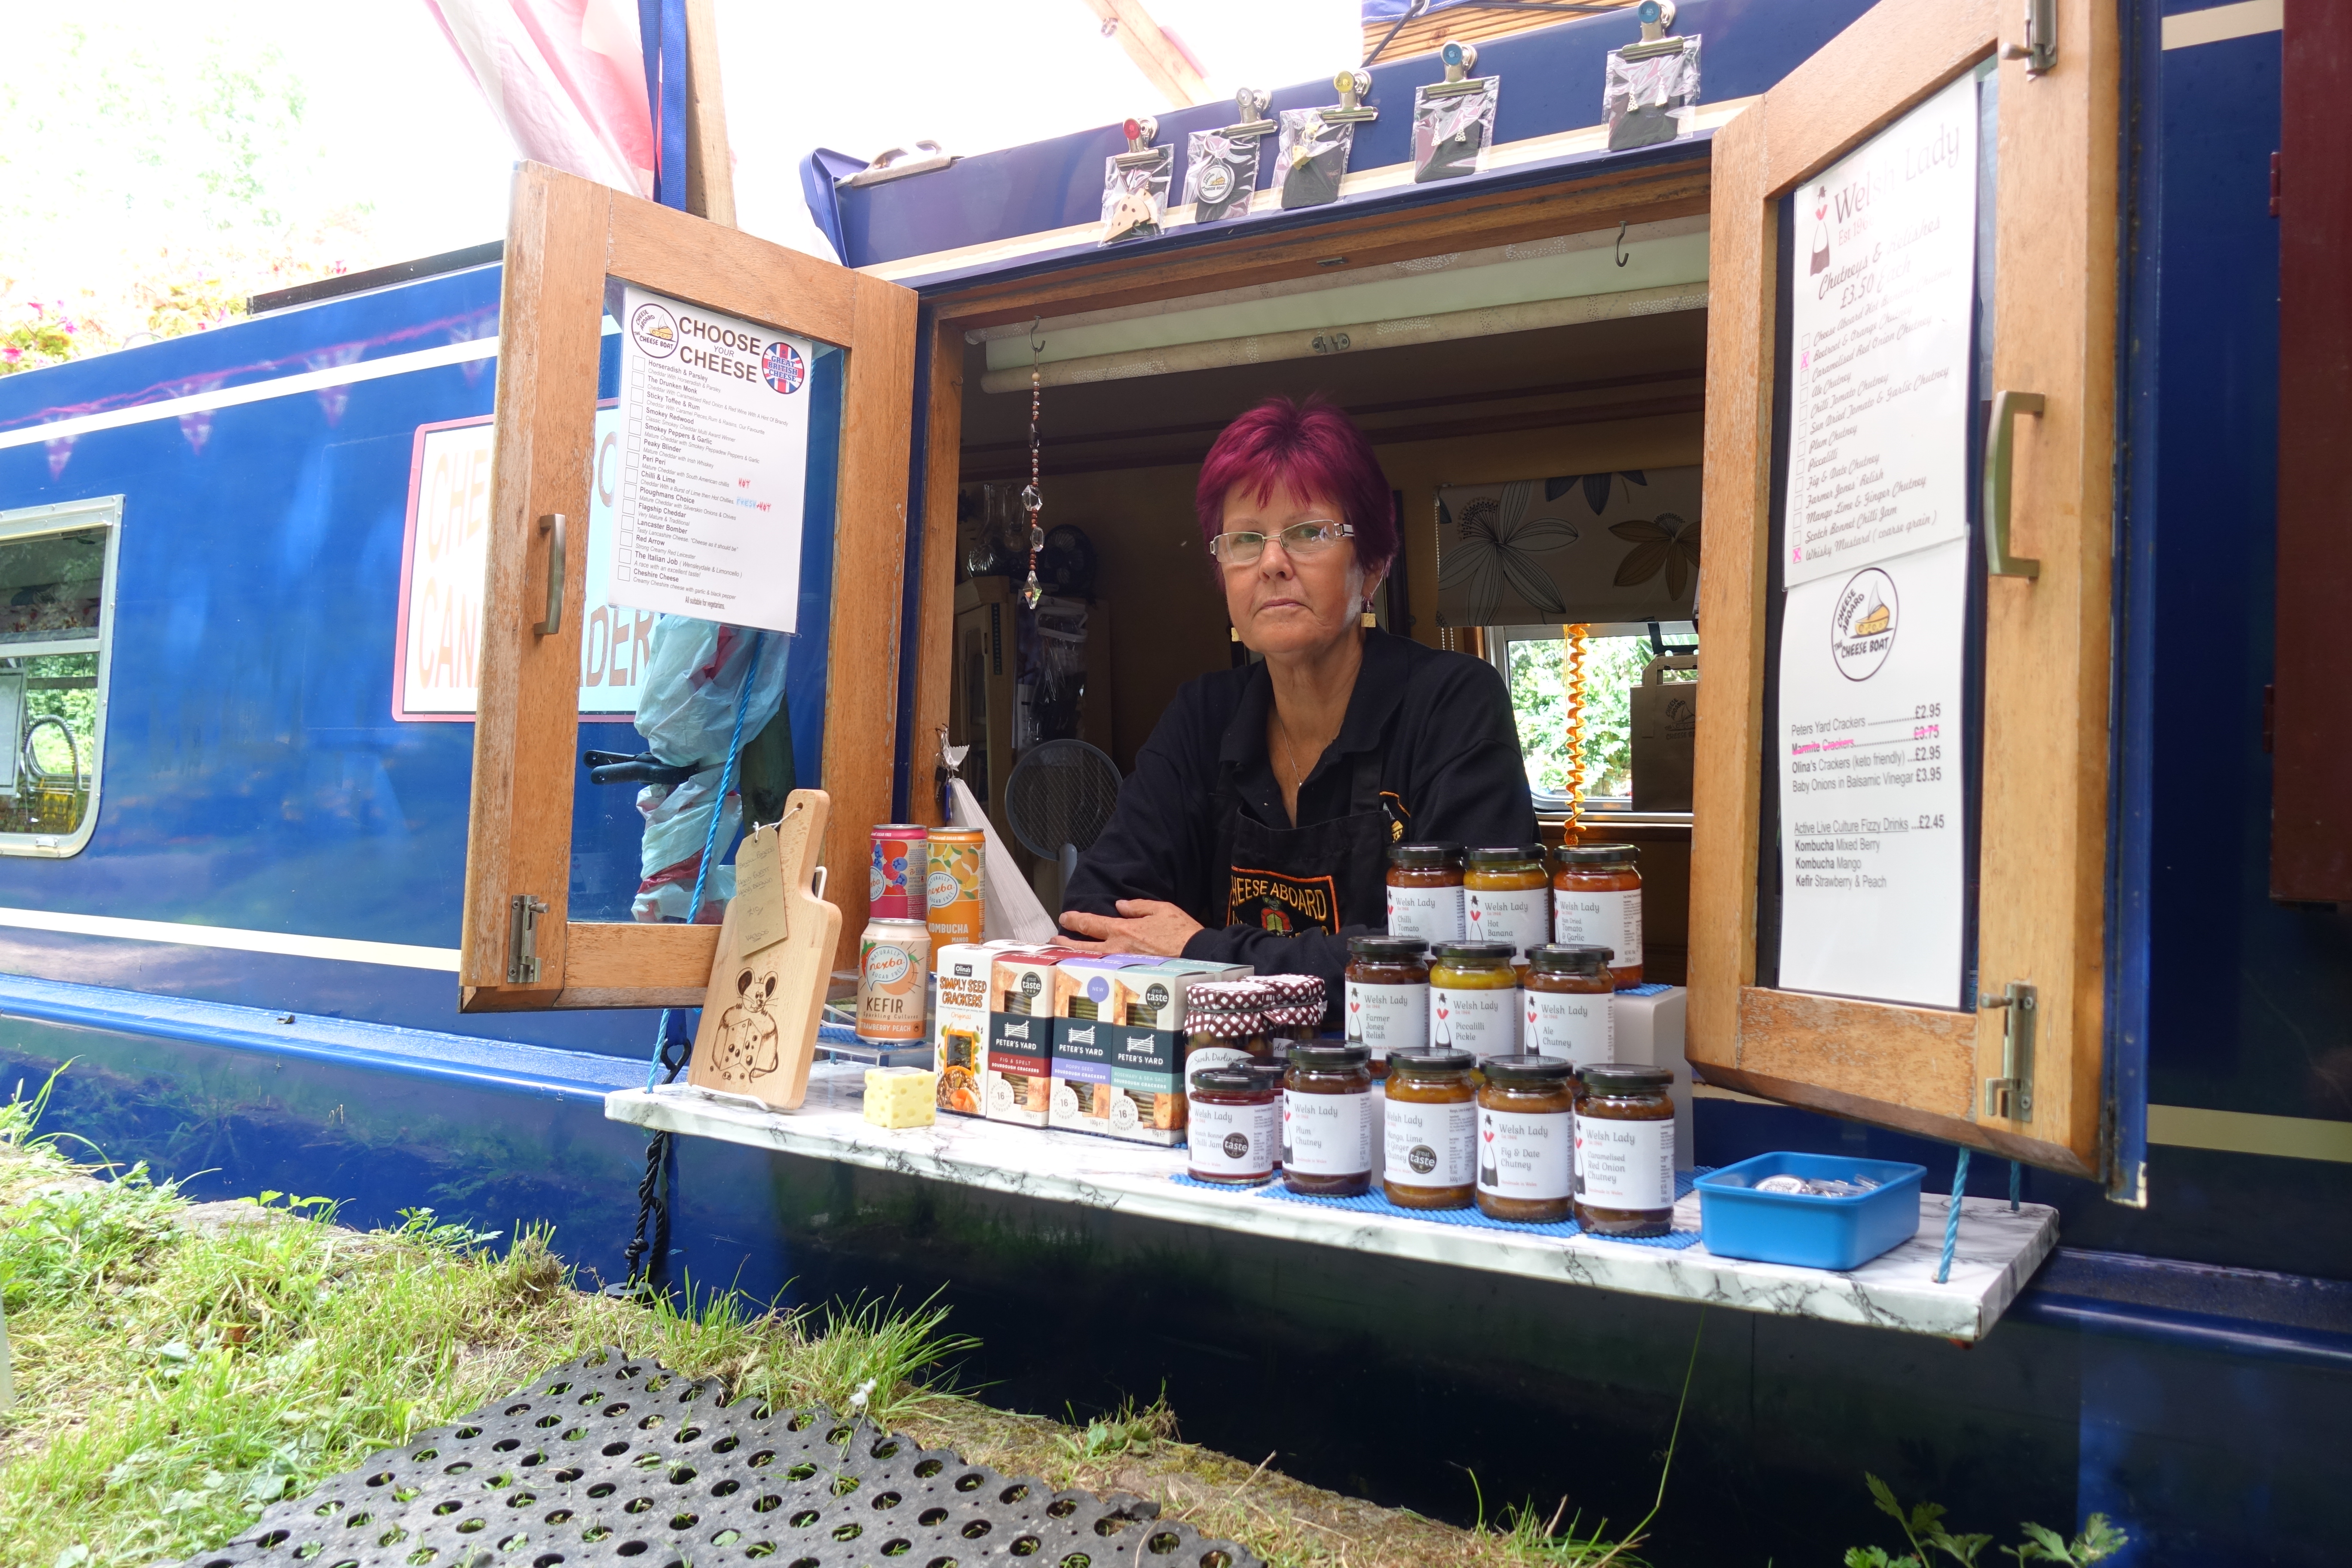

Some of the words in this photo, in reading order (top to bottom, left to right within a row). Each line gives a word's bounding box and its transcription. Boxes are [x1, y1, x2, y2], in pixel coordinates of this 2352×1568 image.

[1906, 122, 1959, 182] Lady
[1819, 255, 1868, 300] Chutneys
[1841, 272, 1874, 309] £3.50
[636, 309, 649, 325] CHEESE
[640, 315, 655, 331] ABOARD
[639, 336, 658, 346] CHEESE
[660, 341, 674, 350] BOAT
[679, 316, 761, 356] CHOOSE
[714, 345, 734, 358] YOUR
[680, 346, 757, 383] CHEESE
[768, 361, 798, 375] BRITISH
[771, 356, 795, 368] GREAT
[648, 359, 682, 374] Horseradish
[688, 370, 708, 383] Parsley
[769, 369, 796, 382] CHEESE
[647, 375, 658, 383] The
[659, 378, 682, 390] Drunken
[683, 385, 697, 394] Monk
[646, 391, 664, 402] Sticky
[665, 395, 681, 405] Toffee
[688, 401, 700, 410] Rum
[646, 406, 668, 419] Smokey
[669, 412, 694, 424] Redwood
[645, 422, 667, 435] Smokey
[668, 428, 690, 439] Peppers
[697, 435, 712, 445] Garlic
[1808, 438, 1827, 454] Plum
[1828, 425, 1857, 446] Chutney
[643, 438, 660, 450] Peaky
[662, 442, 681, 453] Blinder
[642, 454, 653, 462] Peri
[654, 457, 665, 465] Peri
[641, 470, 655, 479] Chilli
[662, 475, 676, 484] Lime
[1806, 475, 1819, 490] Fig
[1829, 465, 1847, 479] Date
[1848, 454, 1880, 475] Chutney
[738, 478, 750, 489] HOT
[640, 486, 674, 499] Ploughmans
[675, 494, 695, 504] Choice
[638, 502, 662, 514] Flagship
[663, 507, 686, 518] Cheddar
[736, 497, 756, 509] FRESH
[637, 518, 665, 530] Lancaster
[665, 524, 688, 534] Bomber
[1804, 526, 1828, 544] Scotch
[1829, 518, 1855, 536] Bonnet
[1856, 511, 1877, 529] Chilli
[1878, 506, 1897, 522] Jam
[636, 534, 647, 542] Red
[647, 536, 665, 545] Arrow
[634, 550, 646, 559] The
[647, 553, 665, 563] Italian
[666, 557, 678, 565] Job
[633, 568, 658, 579] Cheshire
[659, 573, 679, 582] Cheese
[1837, 589, 1856, 628] CHEESE
[1843, 594, 1865, 635] ABOARD
[1841, 642, 1867, 659] CHEESE
[1869, 637, 1890, 652] BOAT
[1791, 724, 1813, 736] Peters
[1814, 720, 1831, 733] Yard
[1832, 717, 1865, 731] Crackers
[1792, 760, 1817, 774] Olina's
[1818, 758, 1850, 771] Crackers
[1852, 755, 1871, 769] (keto
[1873, 751, 1905, 766] friendly)
[1792, 780, 1810, 793] Baby
[1811, 778, 1836, 791] Onions
[1838, 778, 1844, 788] in
[1846, 775, 1880, 788] Balsamic
[1883, 772, 1914, 786] Vinegar
[1915, 767, 1942, 782] £3.95
[1794, 822, 1815, 834] Active
[1816, 821, 1831, 833] Live
[1832, 820, 1859, 833] Culture
[1861, 818, 1880, 832] Fizzy
[1883, 818, 1908, 831] Drinks
[1795, 839, 1834, 851] Kombucha
[1836, 838, 1857, 851] Mixed
[1859, 837, 1880, 852] Berry
[1795, 857, 1835, 869] Kombucha
[1836, 857, 1861, 871] Mango
[1795, 874, 1813, 887] Kefir
[1814, 874, 1852, 889] Strawberry
[1862, 874, 1886, 888] Peach
[928, 882, 952, 896] nexba
[1231, 875, 1268, 906] HEESE
[1270, 882, 1327, 921] ABOARD
[1484, 902, 1508, 911] Welsh
[1510, 902, 1528, 913] Lady
[928, 923, 968, 934] KOMBUCHA
[870, 958, 902, 971] nexba
[940, 976, 967, 991] SIMPLY
[968, 979, 987, 993] SEED
[1022, 981, 1041, 990] taste
[867, 996, 903, 1013] KEFIR
[942, 991, 983, 1008] CRACKERS
[1364, 995, 1387, 1004] Welsh
[1390, 995, 1408, 1007] Lady
[1453, 1001, 1478, 1010] Welsh
[1480, 1001, 1498, 1012] Lady
[951, 1012, 971, 1020] Original
[1366, 1013, 1390, 1022] Farmer
[1541, 1004, 1565, 1014] Welsh
[1568, 1006, 1588, 1017] Lady
[1456, 1022, 1485, 1030] Piccalilli
[1543, 1026, 1553, 1035] Ale
[1366, 1030, 1385, 1039] Relish
[1455, 1032, 1476, 1041] Pickle
[996, 1039, 1019, 1048] PETER'S
[1059, 1044, 1083, 1054] PETER'S
[1085, 1047, 1103, 1056] YARD
[1543, 1037, 1571, 1049] Chutney
[1118, 1053, 1142, 1063] PETER'S
[1144, 1057, 1163, 1065] YARD
[1294, 1104, 1315, 1114] Welsh
[1318, 1106, 1338, 1118] Lady
[1296, 1125, 1311, 1135] Plum
[1499, 1124, 1525, 1135] Welsh
[1528, 1125, 1548, 1138] Lady
[1295, 1136, 1322, 1149] Chutney
[1501, 1147, 1511, 1158] Fig
[1513, 1148, 1520, 1157] &
[1522, 1148, 1540, 1158] Date
[1501, 1158, 1531, 1172] Chutney
